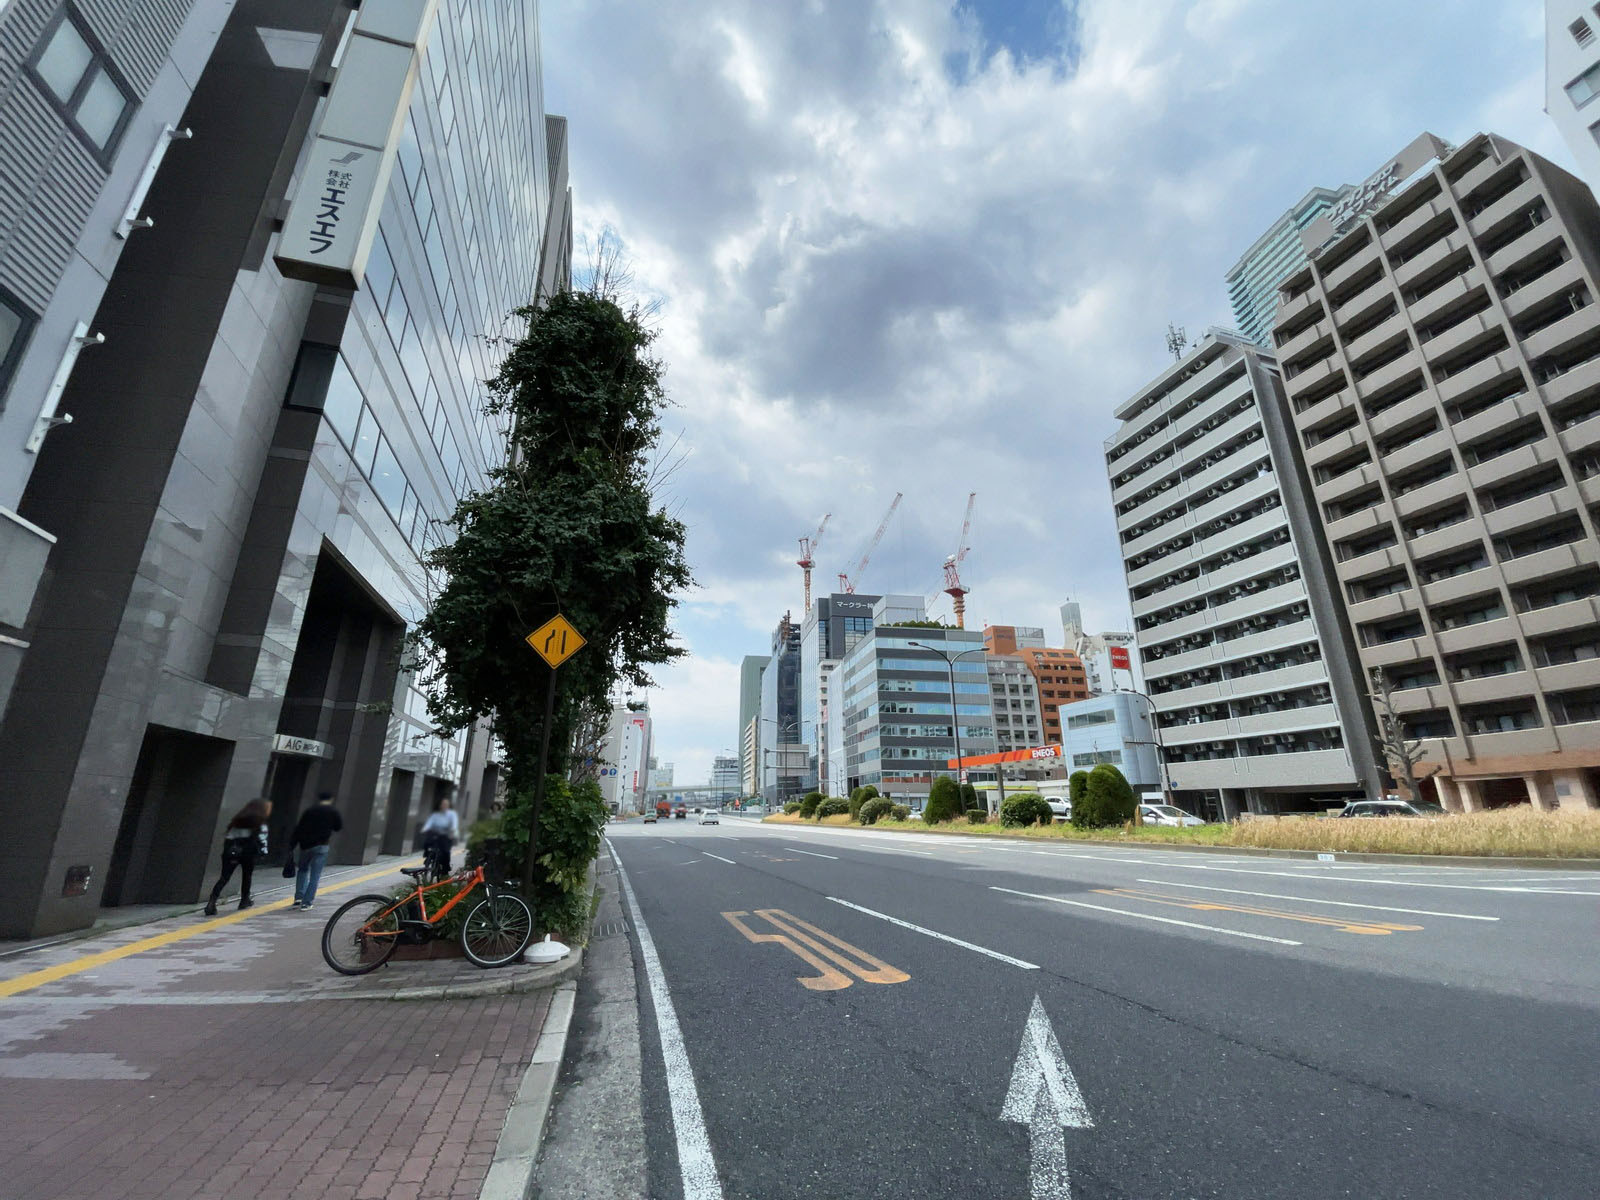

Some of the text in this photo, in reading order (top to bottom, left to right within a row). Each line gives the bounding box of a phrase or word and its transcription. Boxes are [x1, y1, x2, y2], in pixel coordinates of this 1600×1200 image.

[309, 187, 345, 254] エスエフ
[284, 738, 302, 751] AIG
[1031, 747, 1055, 758] ENEOS
[720, 908, 912, 991] 50
